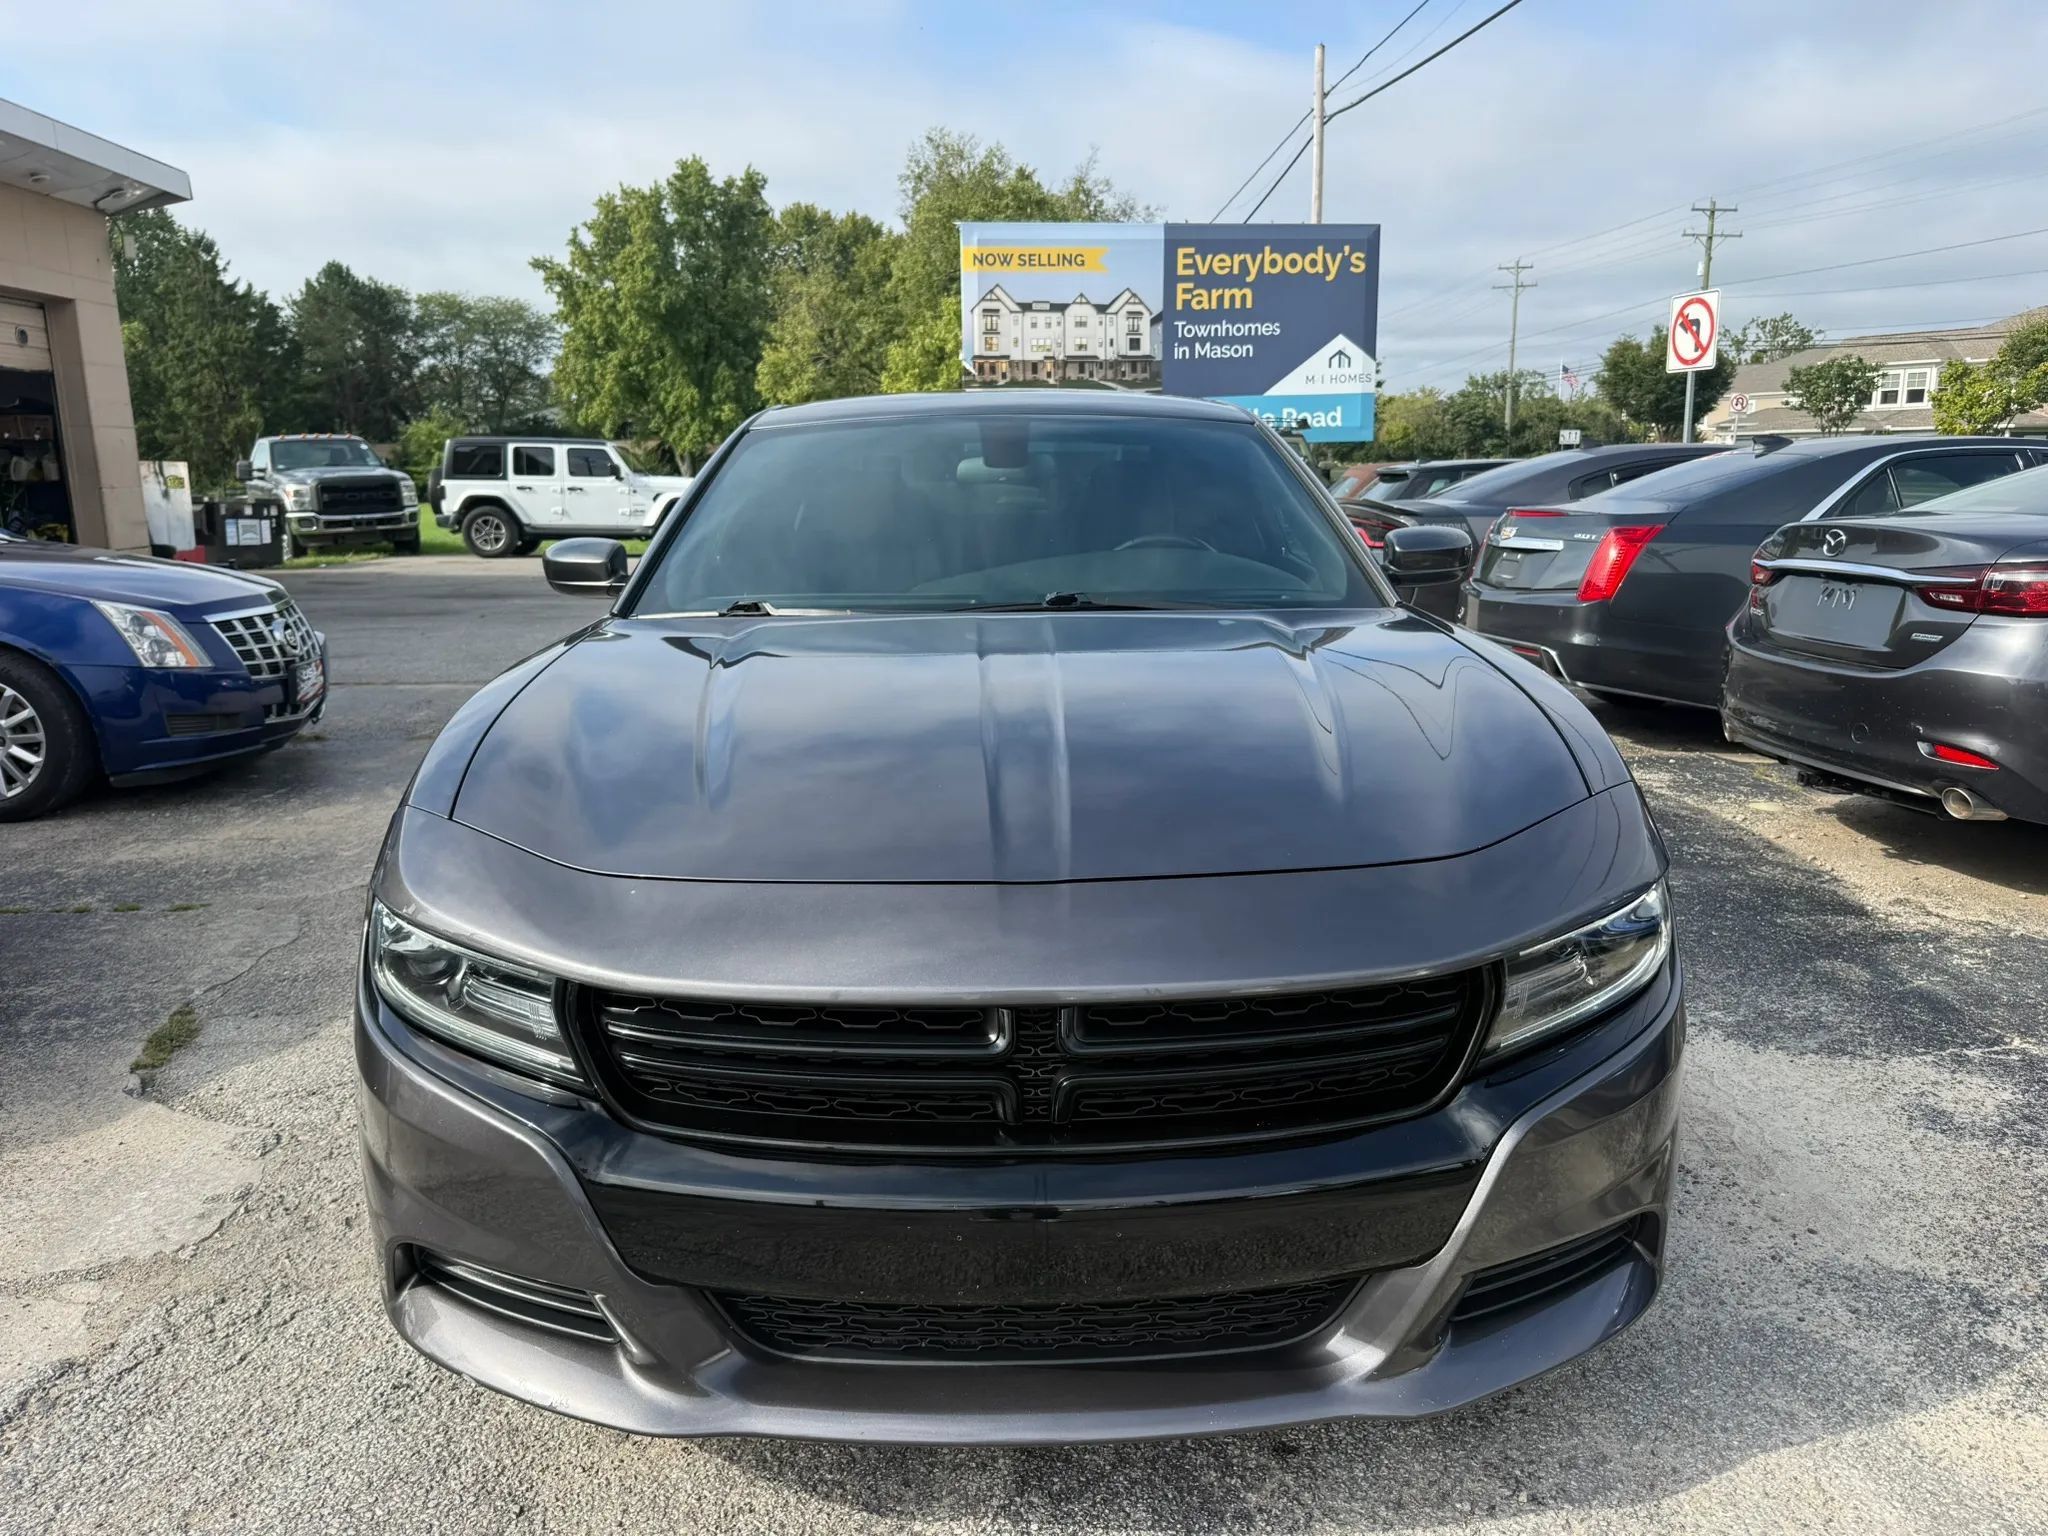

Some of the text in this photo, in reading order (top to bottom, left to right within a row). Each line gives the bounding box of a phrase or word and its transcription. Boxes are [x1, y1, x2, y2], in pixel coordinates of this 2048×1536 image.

[973, 252, 1086, 267] NOW SELLING
[1176, 245, 1367, 283] Everybody's
[1175, 283, 1254, 311] Farm
[1174, 320, 1281, 339] Townhomes
[1174, 341, 1254, 360] in Mason
[1329, 373, 1373, 384] HOMES
[1281, 405, 1343, 428] Road
